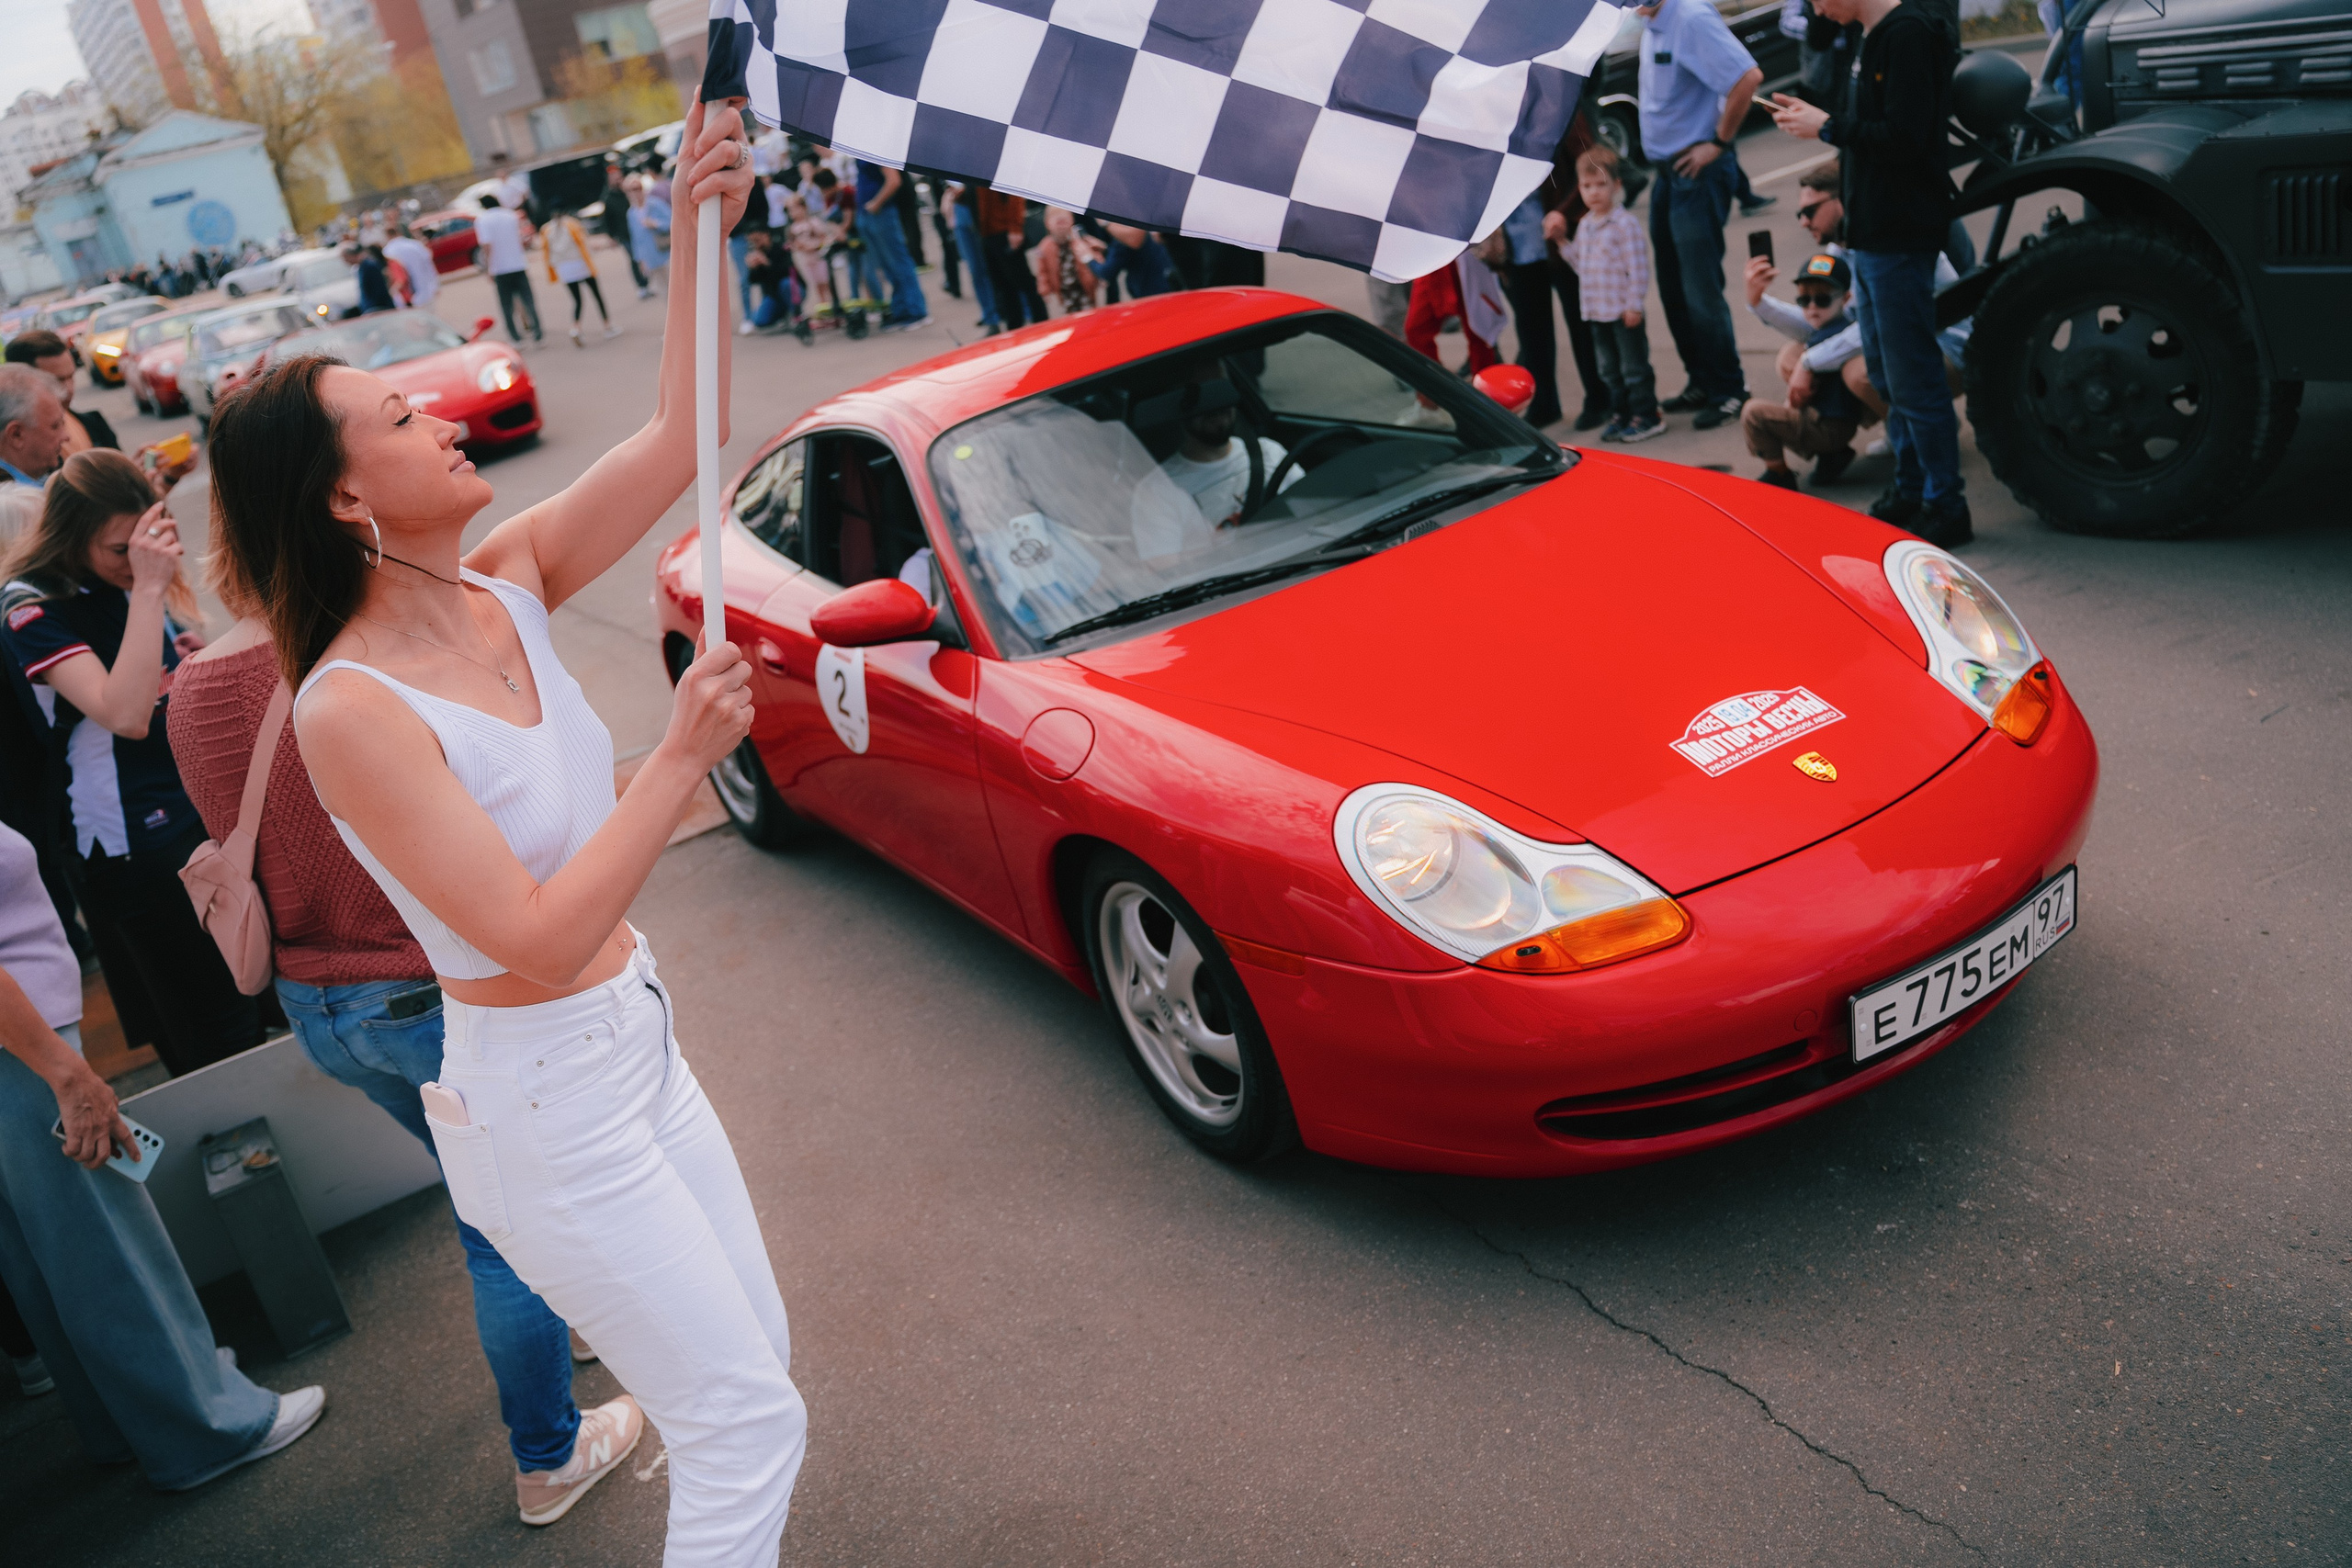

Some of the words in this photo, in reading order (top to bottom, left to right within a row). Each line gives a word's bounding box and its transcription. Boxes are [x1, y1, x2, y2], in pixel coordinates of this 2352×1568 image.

[1747, 693, 1781, 712] 2025
[1677, 719, 1773, 766] МОТОРЫ
[1761, 690, 1829, 731] ВЕСНЫ
[1691, 715, 1725, 735] 2025
[1708, 753, 1743, 773] РАЛЛИ
[1740, 719, 1815, 757] КЛАССИЧЕСКИХ
[1813, 711, 1838, 724] АВТО
[2038, 883, 2064, 933] 97
[2036, 926, 2056, 952] RUS
[589, 1434, 611, 1470] N
